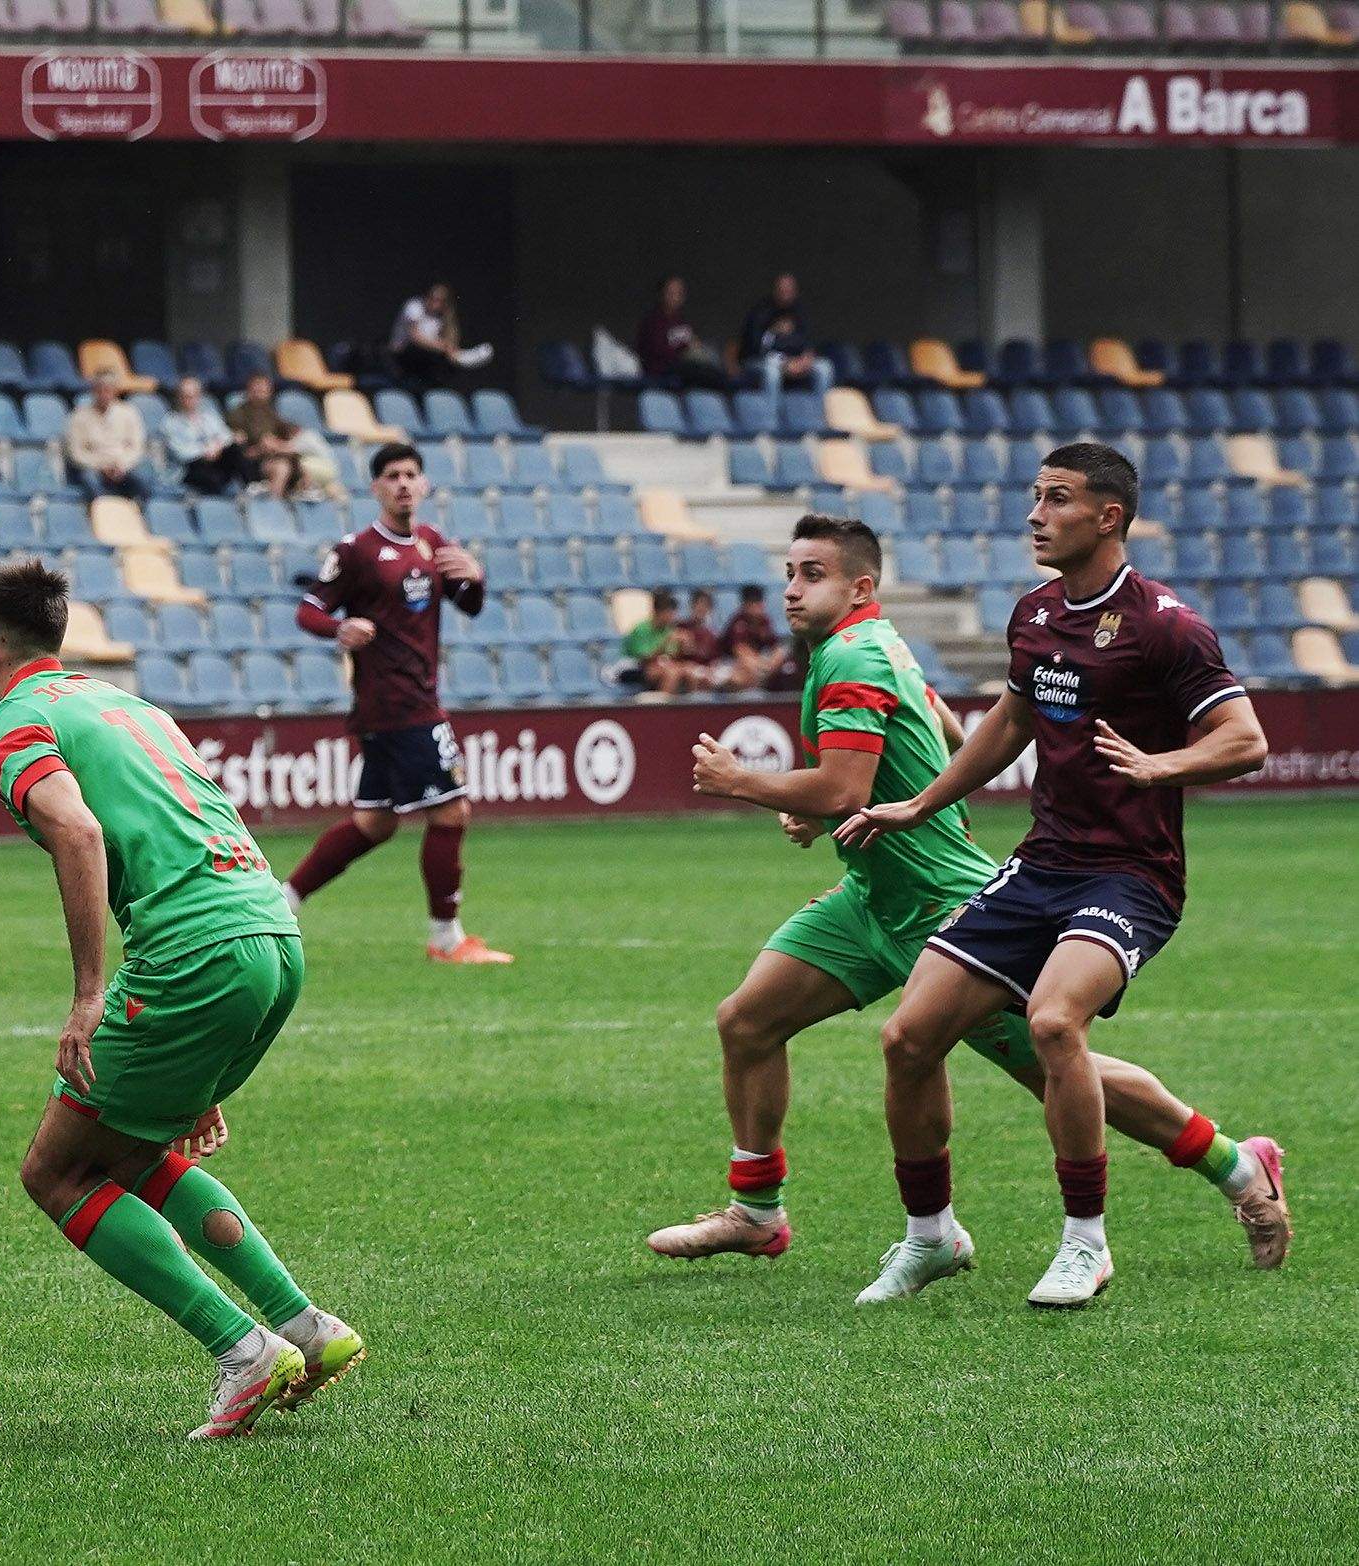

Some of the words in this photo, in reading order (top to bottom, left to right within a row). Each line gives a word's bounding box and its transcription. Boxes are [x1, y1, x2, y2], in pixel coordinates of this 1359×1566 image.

[1116, 74, 1159, 134] A
[1167, 75, 1310, 135] Barca
[1033, 665, 1080, 688] Estrella
[1034, 683, 1078, 705] Galicia
[461, 727, 568, 802] licia
[1071, 906, 1135, 939] ABANCA
